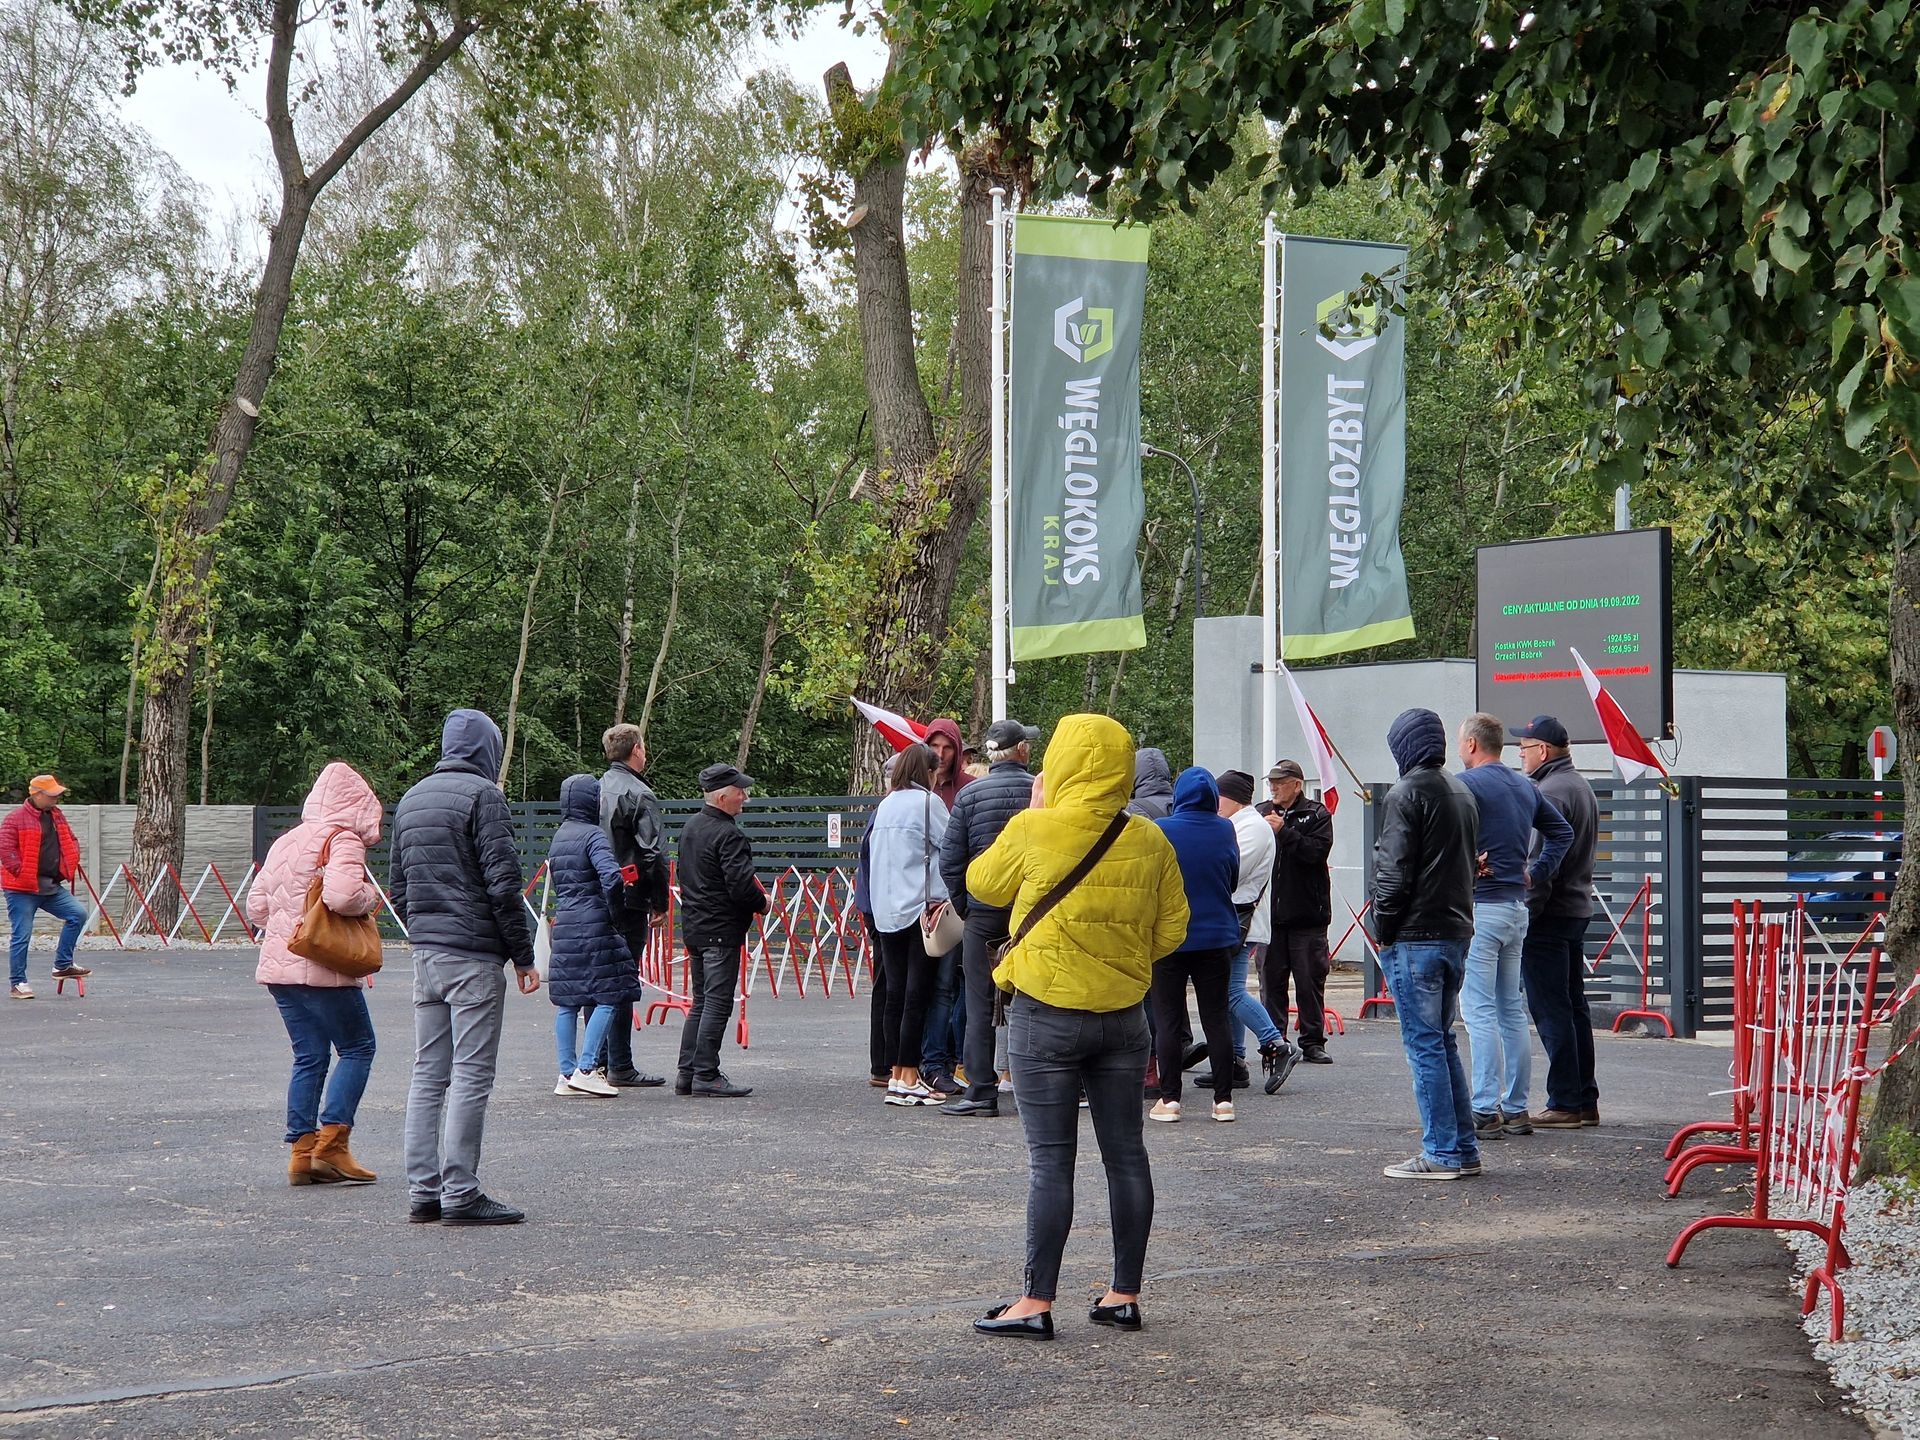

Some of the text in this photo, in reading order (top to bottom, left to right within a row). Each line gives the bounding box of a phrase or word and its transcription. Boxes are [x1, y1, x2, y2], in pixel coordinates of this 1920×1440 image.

[1058, 376, 1102, 586] WĘGLOKOKS
[1327, 373, 1367, 590] WĘGLOZBYT
[1042, 515, 1060, 586] KRAJ
[1503, 595, 1640, 615] CENY AKTUALNE OD DNIA 19.09.2022
[1494, 641, 1515, 651] Kostka
[1516, 639, 1533, 649] KWK
[1533, 638, 1556, 648] Bobrek
[1494, 652, 1517, 661] Orzech
[1520, 650, 1543, 659] Bobrek
